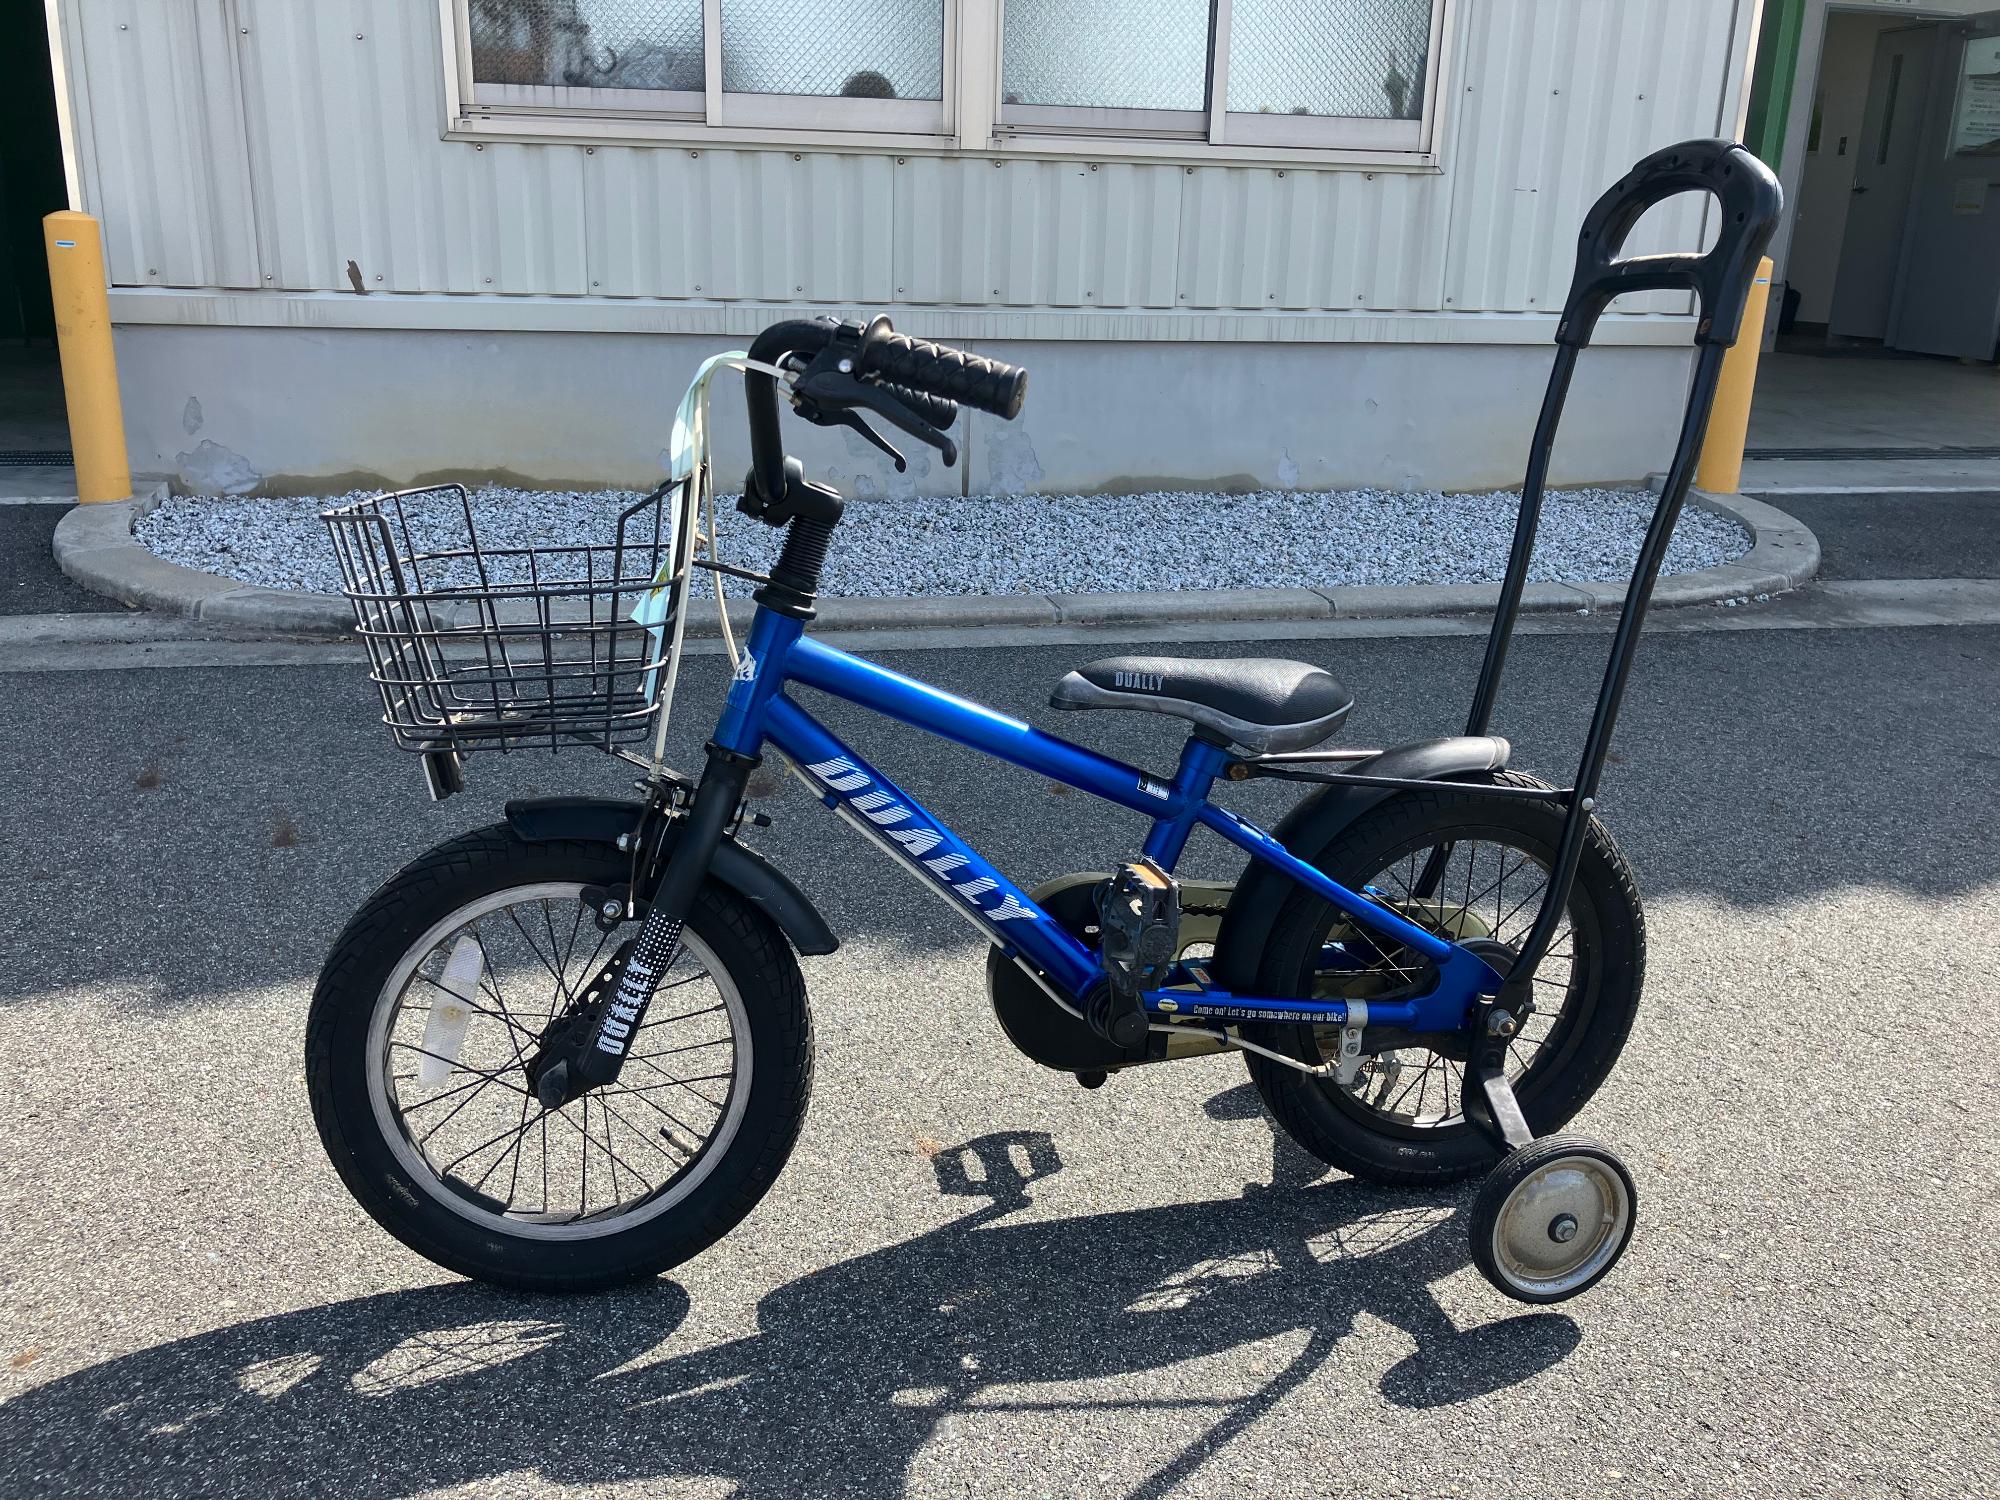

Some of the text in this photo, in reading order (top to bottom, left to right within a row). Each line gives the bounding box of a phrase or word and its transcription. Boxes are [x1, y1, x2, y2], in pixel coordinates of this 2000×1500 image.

[1115, 671, 1164, 691] DUALLY
[805, 755, 1040, 921] DUALLY
[596, 955, 654, 1056] DUALLY
[1193, 1004, 1213, 1015] Come
[1214, 1006, 1227, 1016] on!
[1228, 1006, 1246, 1017] Let's
[1247, 1009, 1257, 1019] go
[1258, 1010, 1301, 1020] somewhere
[1301, 1012, 1311, 1021] on
